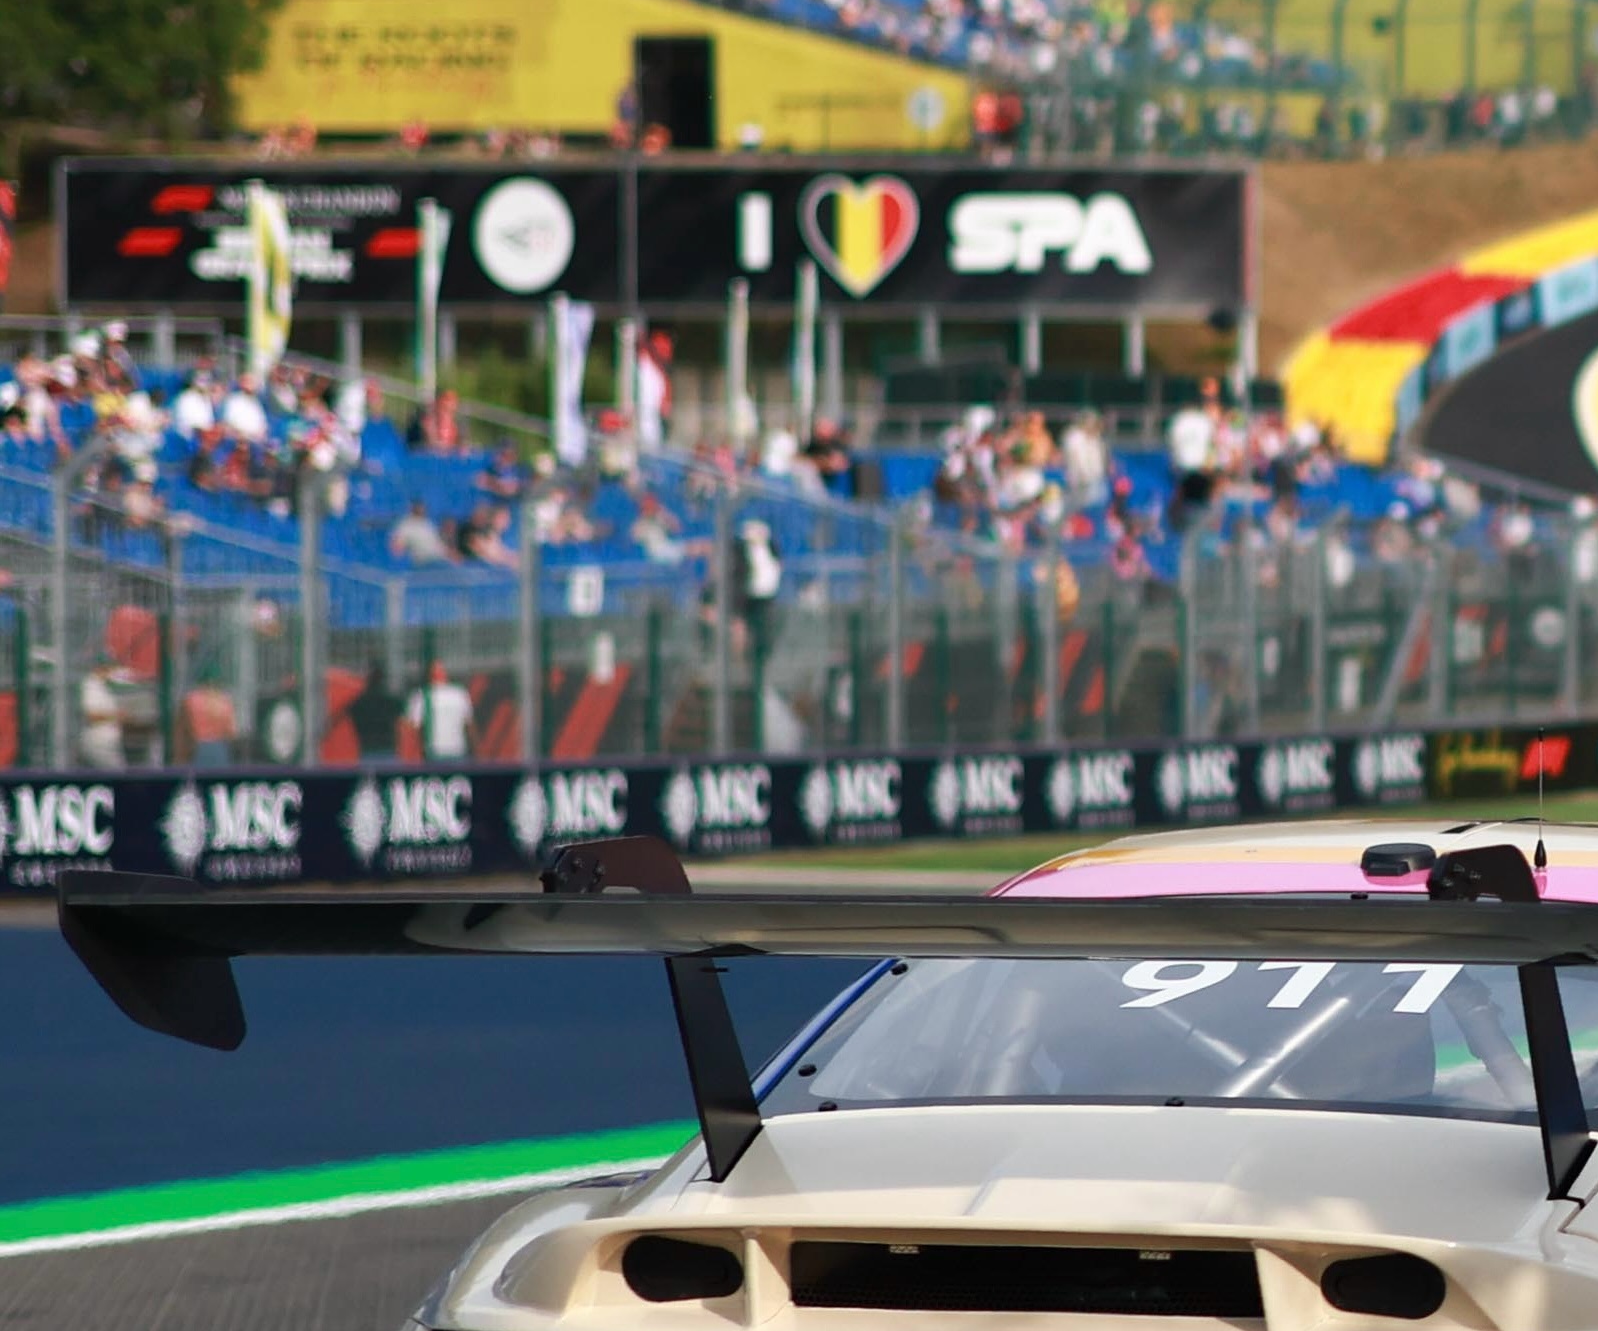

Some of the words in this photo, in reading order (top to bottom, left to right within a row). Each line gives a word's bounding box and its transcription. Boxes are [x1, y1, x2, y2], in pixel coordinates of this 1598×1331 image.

[739, 193, 773, 273] I
[948, 191, 1153, 273] SPA
[551, 769, 628, 835] MSC
[700, 763, 772, 825] MSC
[836, 757, 901, 818] MSC
[963, 754, 1025, 814] MSC
[1079, 749, 1133, 805] MSC
[1187, 745, 1239, 799] MSC
[12, 783, 115, 855] MSC
[210, 780, 302, 851] MSC
[388, 775, 473, 843] MSC
[1120, 959, 1465, 1014] 911
